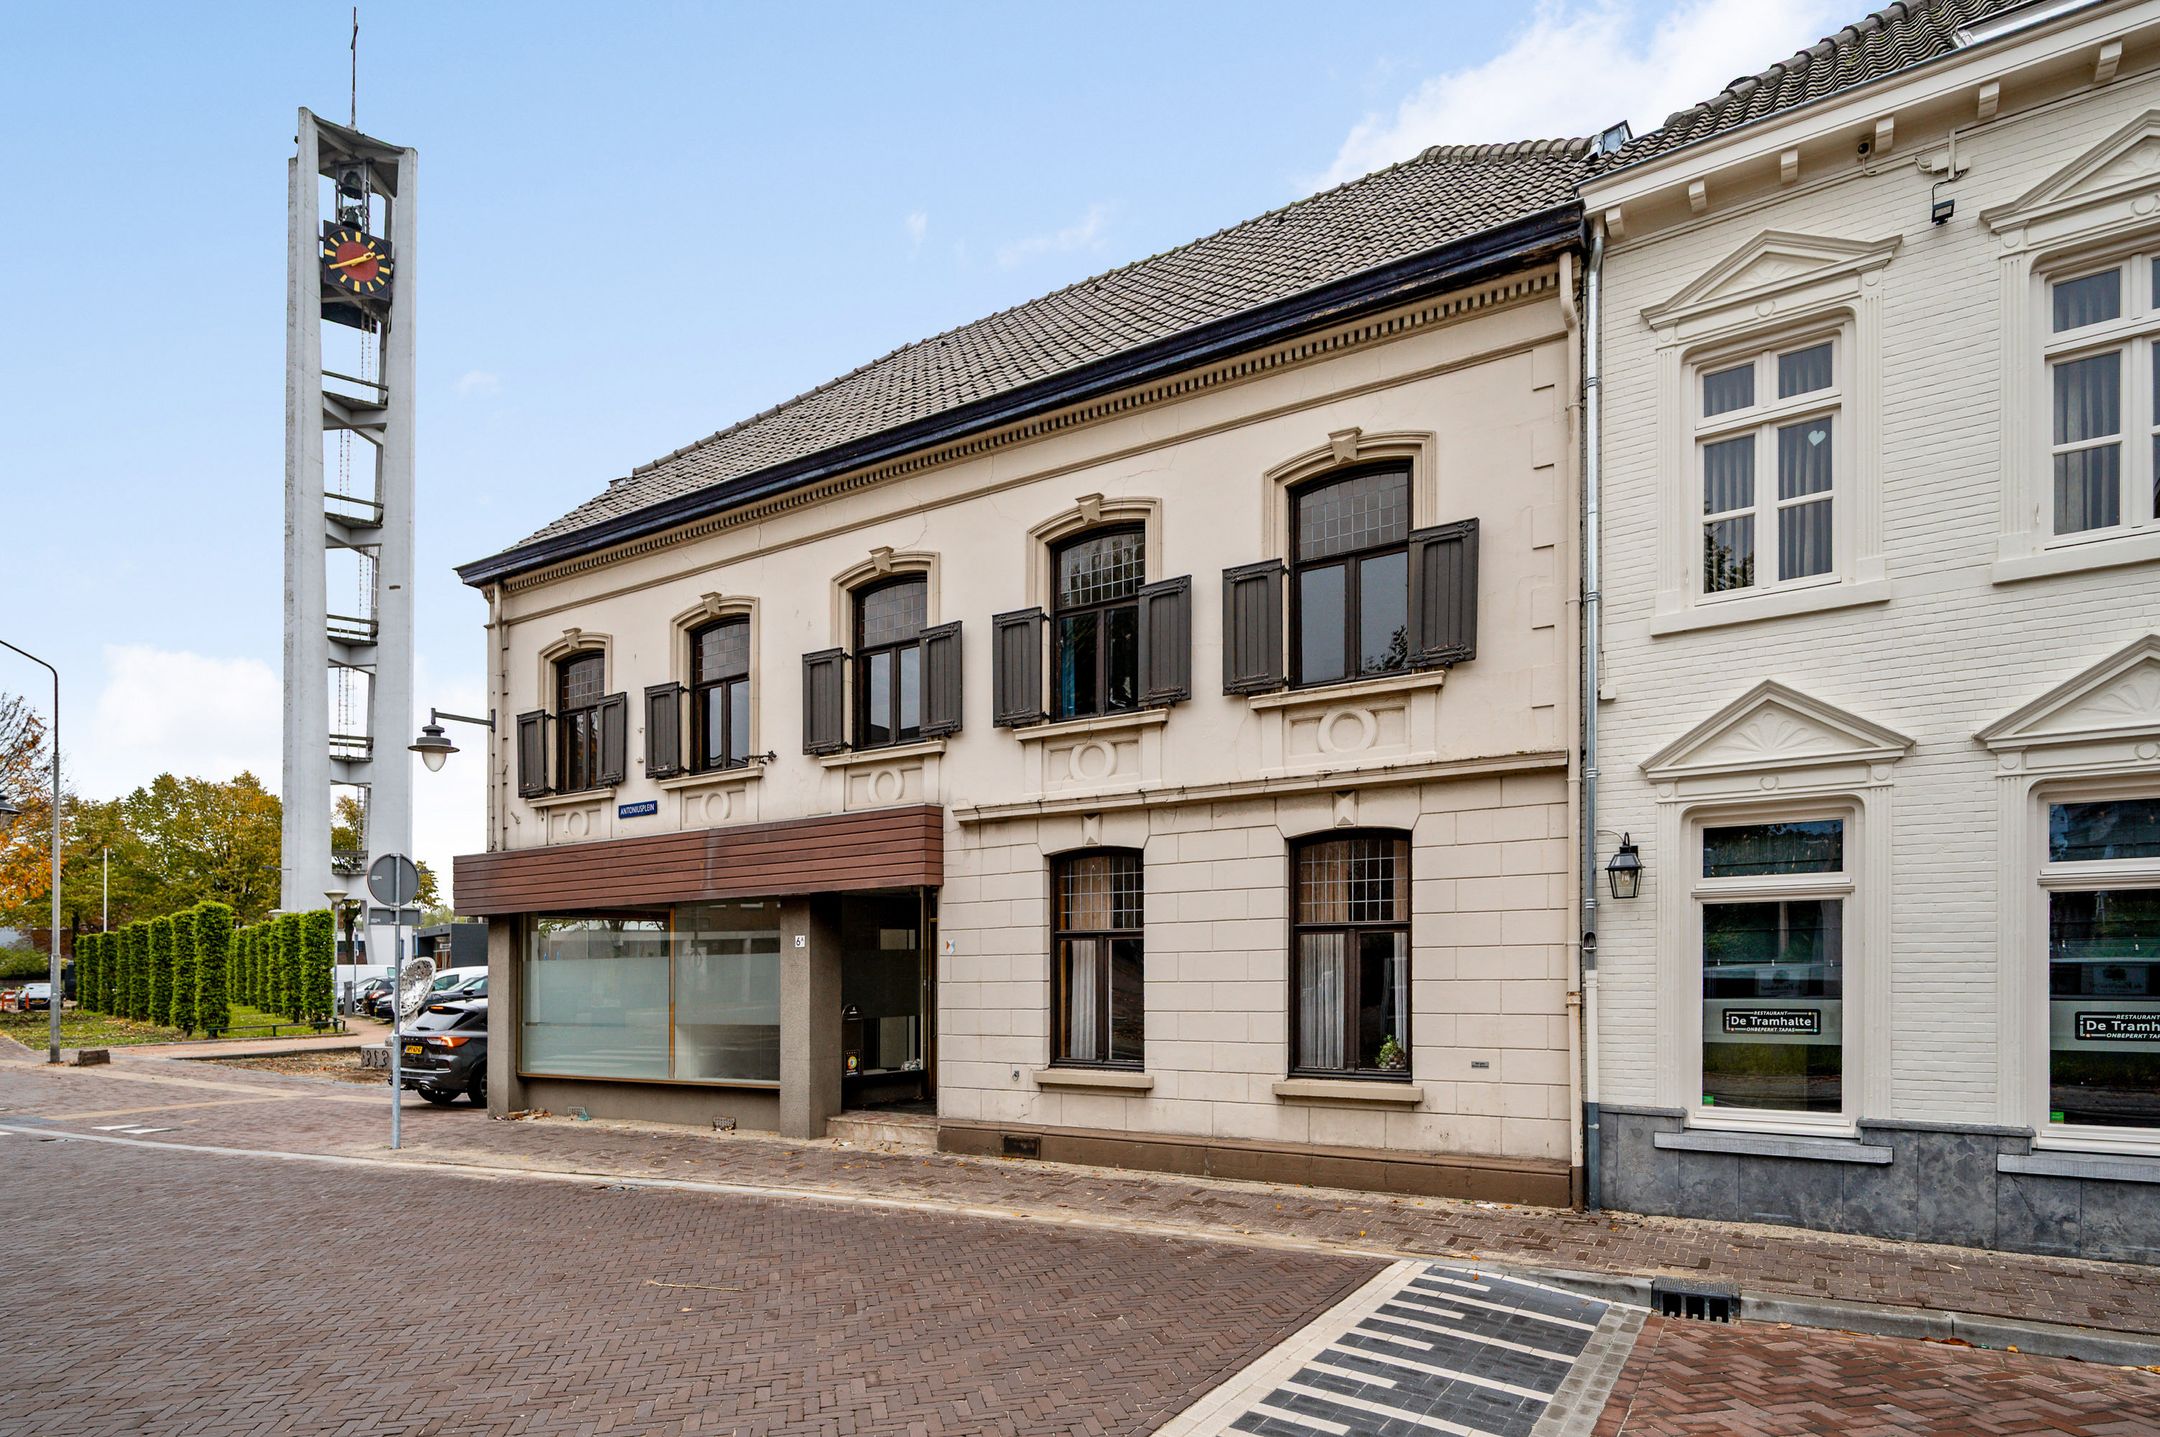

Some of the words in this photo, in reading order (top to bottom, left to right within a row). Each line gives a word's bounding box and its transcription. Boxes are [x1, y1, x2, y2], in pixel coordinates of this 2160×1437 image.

[620, 803, 655, 815] ANTONIUSPLEIN
[1731, 1016, 1747, 1025] De
[1750, 1016, 1812, 1026] Tramhalte
[2086, 1020, 2106, 1031] De
